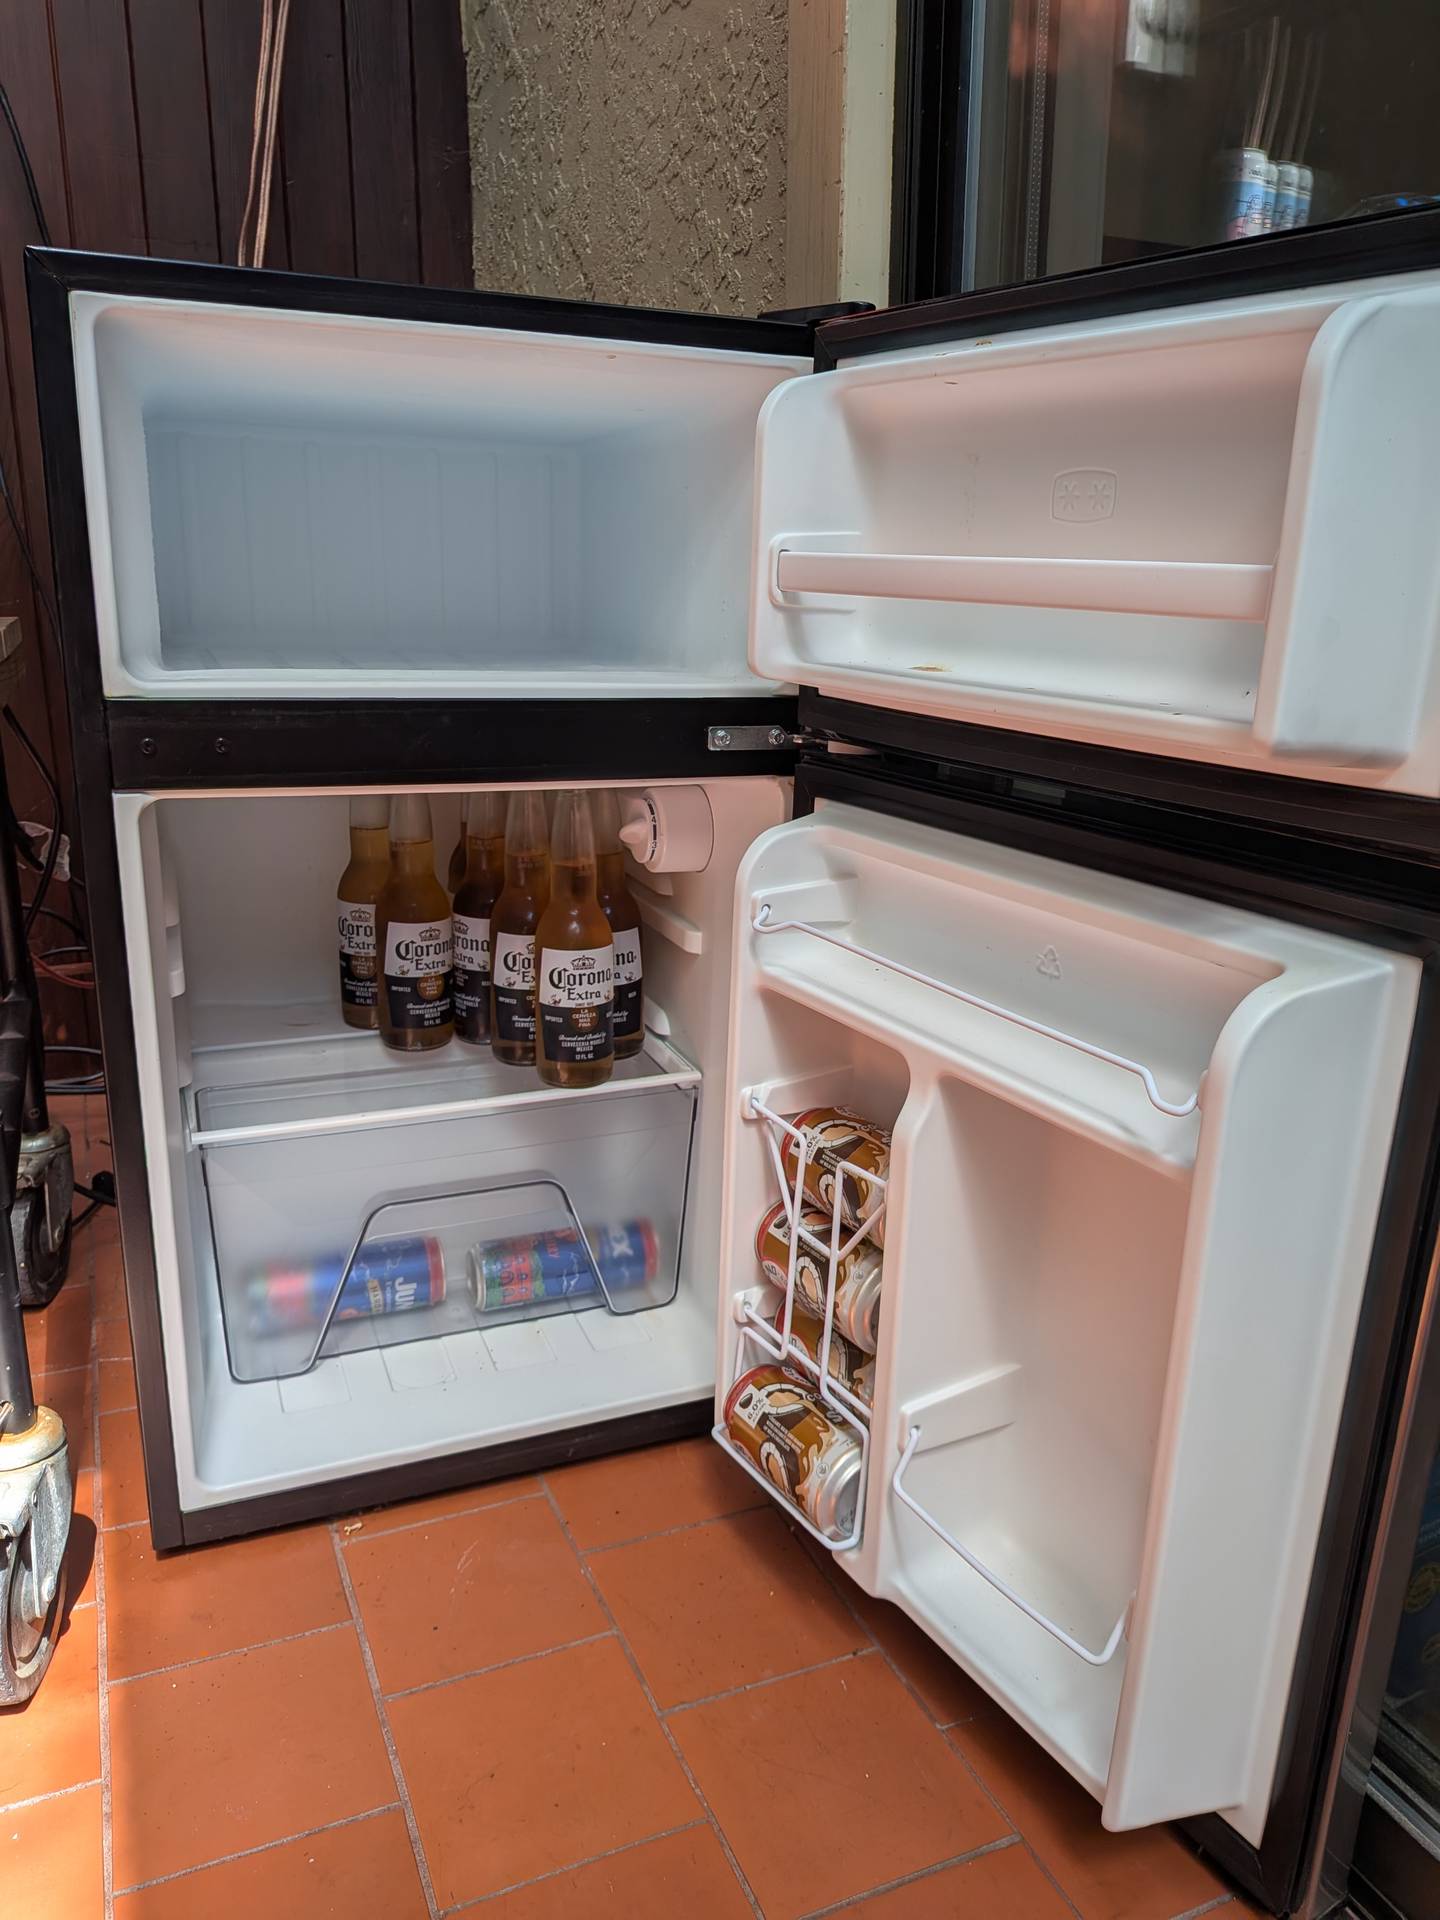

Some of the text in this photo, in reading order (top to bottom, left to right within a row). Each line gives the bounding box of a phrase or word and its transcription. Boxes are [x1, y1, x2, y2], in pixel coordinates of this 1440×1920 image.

[338, 915, 374, 938] Coro
[453, 936, 490, 952] rona
[415, 957, 446, 971] Extra
[548, 967, 613, 992] Corona
[565, 987, 602, 1001] Extra
